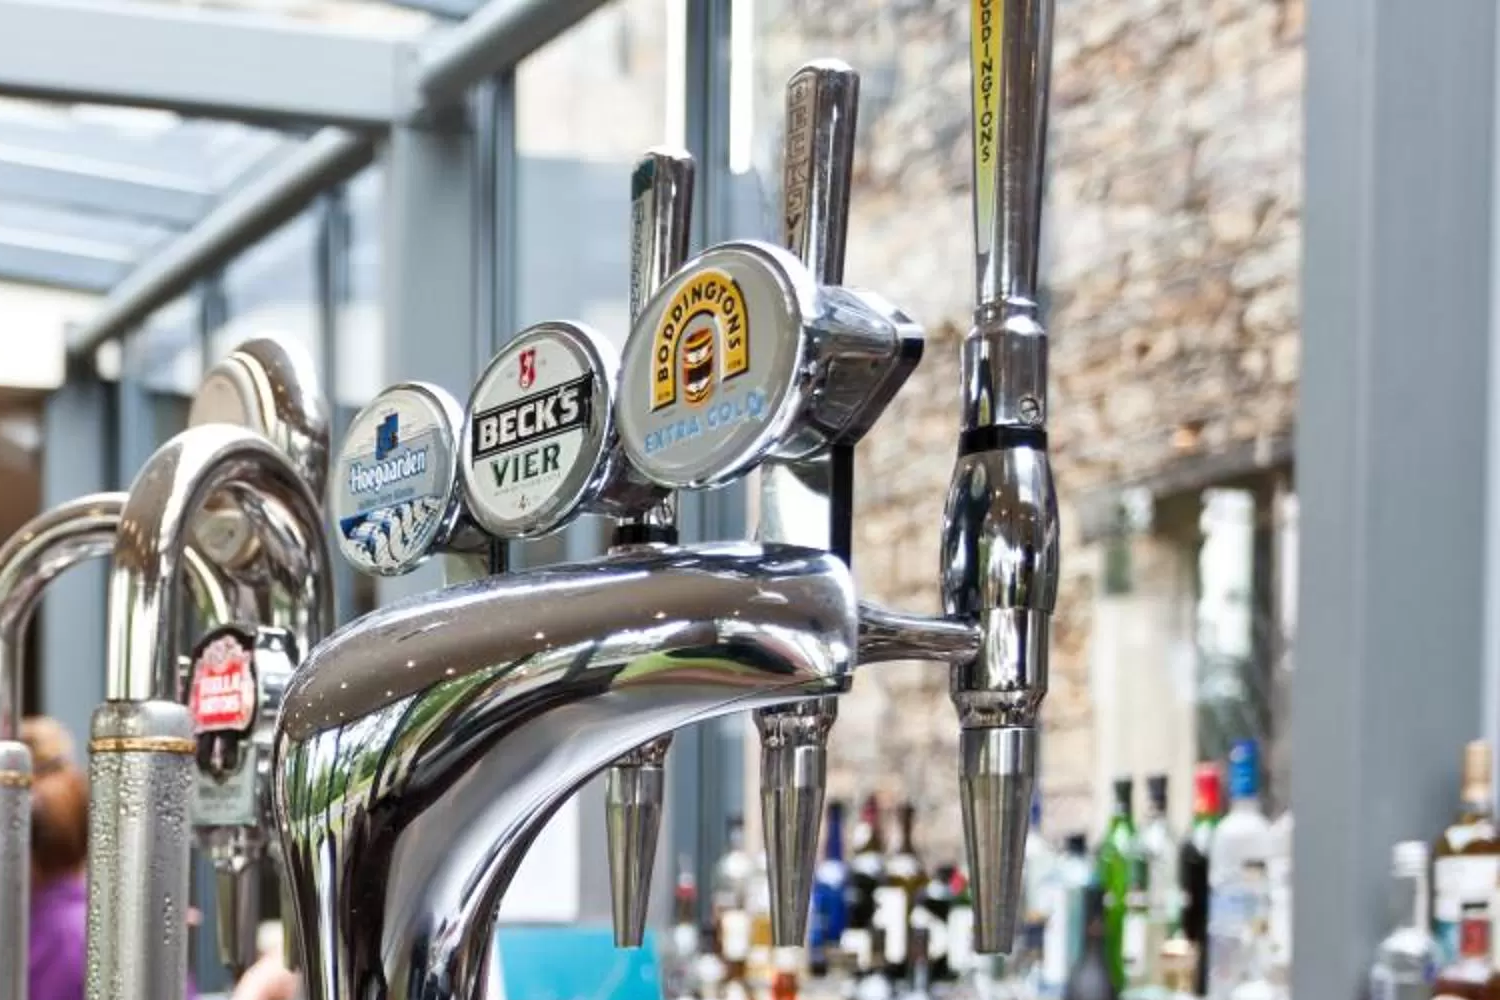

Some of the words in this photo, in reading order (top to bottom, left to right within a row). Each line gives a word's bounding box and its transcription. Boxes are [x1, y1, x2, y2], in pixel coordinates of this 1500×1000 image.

[656, 280, 741, 383] BODDINGTONS
[478, 385, 580, 451] BECK'S
[644, 416, 701, 454] EXTRA
[350, 450, 427, 493] Hoegaarden
[491, 443, 561, 488] VIER
